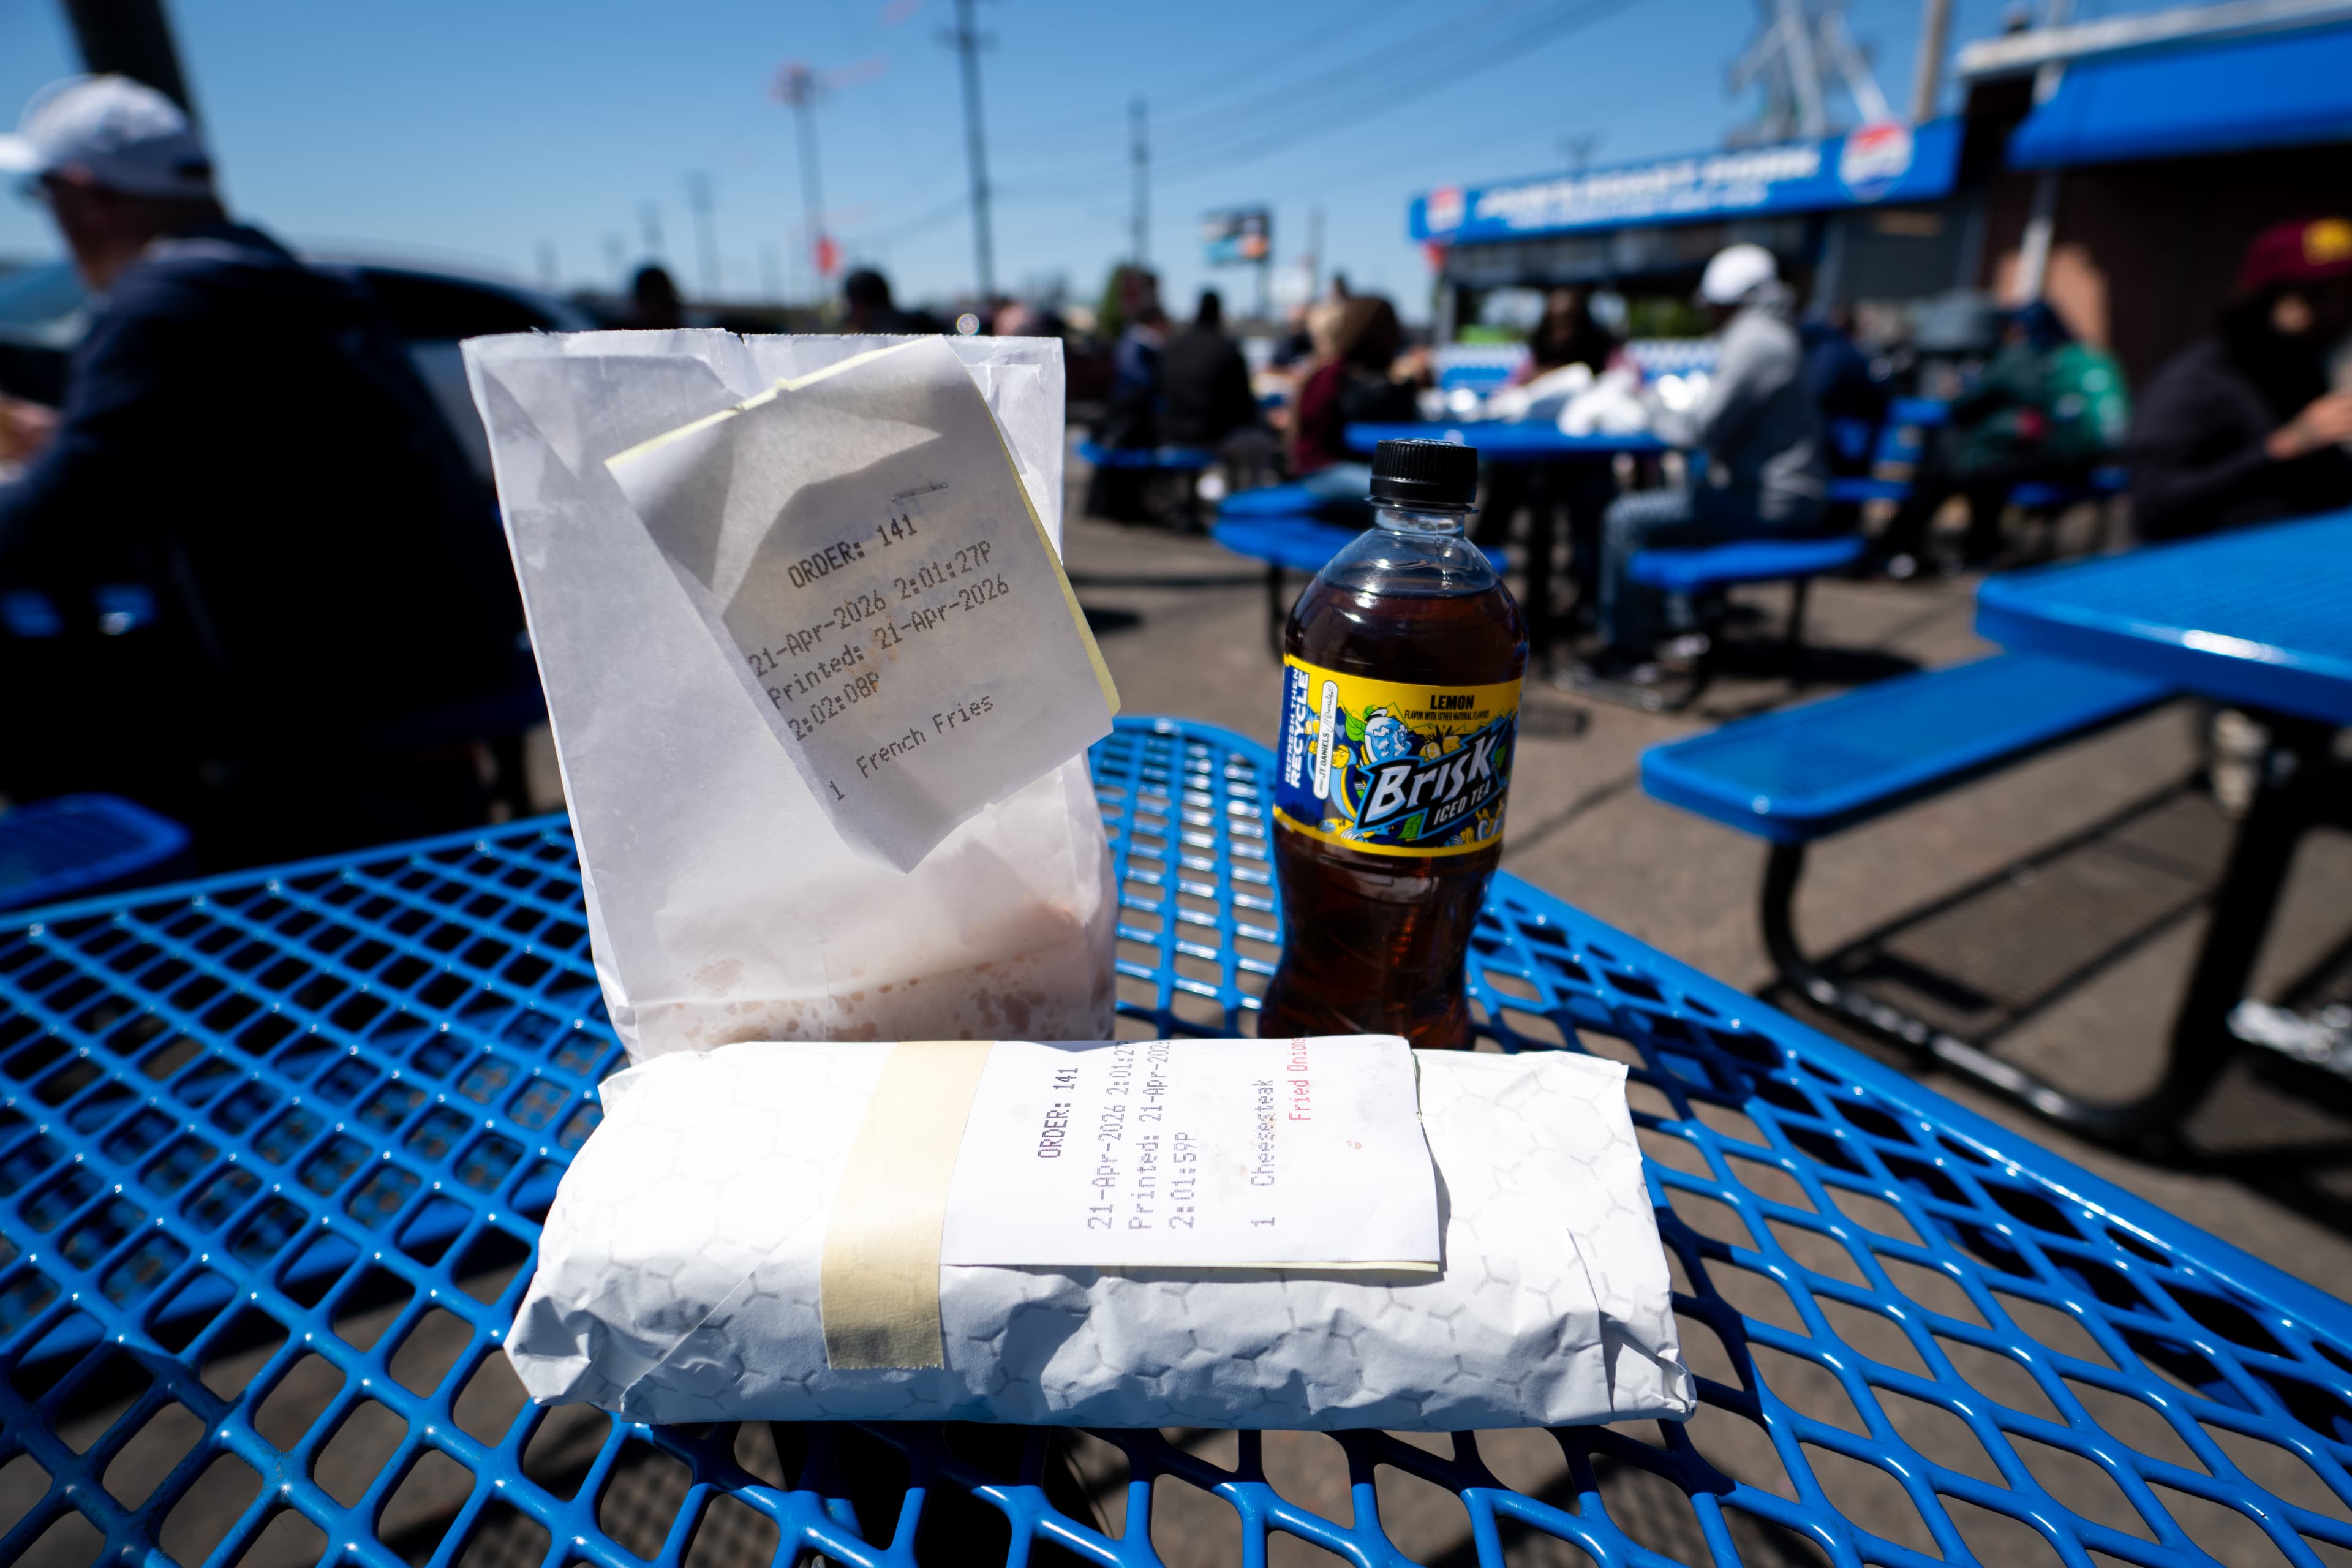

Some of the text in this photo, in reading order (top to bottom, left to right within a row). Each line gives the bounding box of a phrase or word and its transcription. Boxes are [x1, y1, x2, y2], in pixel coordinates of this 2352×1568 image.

[788, 513, 918, 589] ORDER: 141
[748, 540, 991, 678] 21-Apr-2026 2:01:27P
[767, 573, 1009, 710] Printed: 21-Apr-2026
[788, 671, 880, 741] 2:02:08P
[1290, 671, 1310, 789] RECYCLE
[1404, 710, 1490, 721] FLAVOR WITH OTHER NATURAL FLAVORS
[1430, 695, 1475, 710] LEMON
[829, 695, 993, 801] 1 French Fries
[1285, 713, 1295, 783] REFRESH
[1321, 733, 1329, 765] DANIELS
[1433, 779, 1490, 826] ICED TEA
[1038, 1068, 1078, 1158] ORDER: 141
[1287, 1080, 1311, 1121] Fried
[1088, 1105, 1125, 1229] 21-Apr-2026
[1128, 1136, 1159, 1229] Printed:
[1169, 1132, 1197, 1229] 2:01:59P
[1251, 1080, 1275, 1227] 1 Cheesesteak
